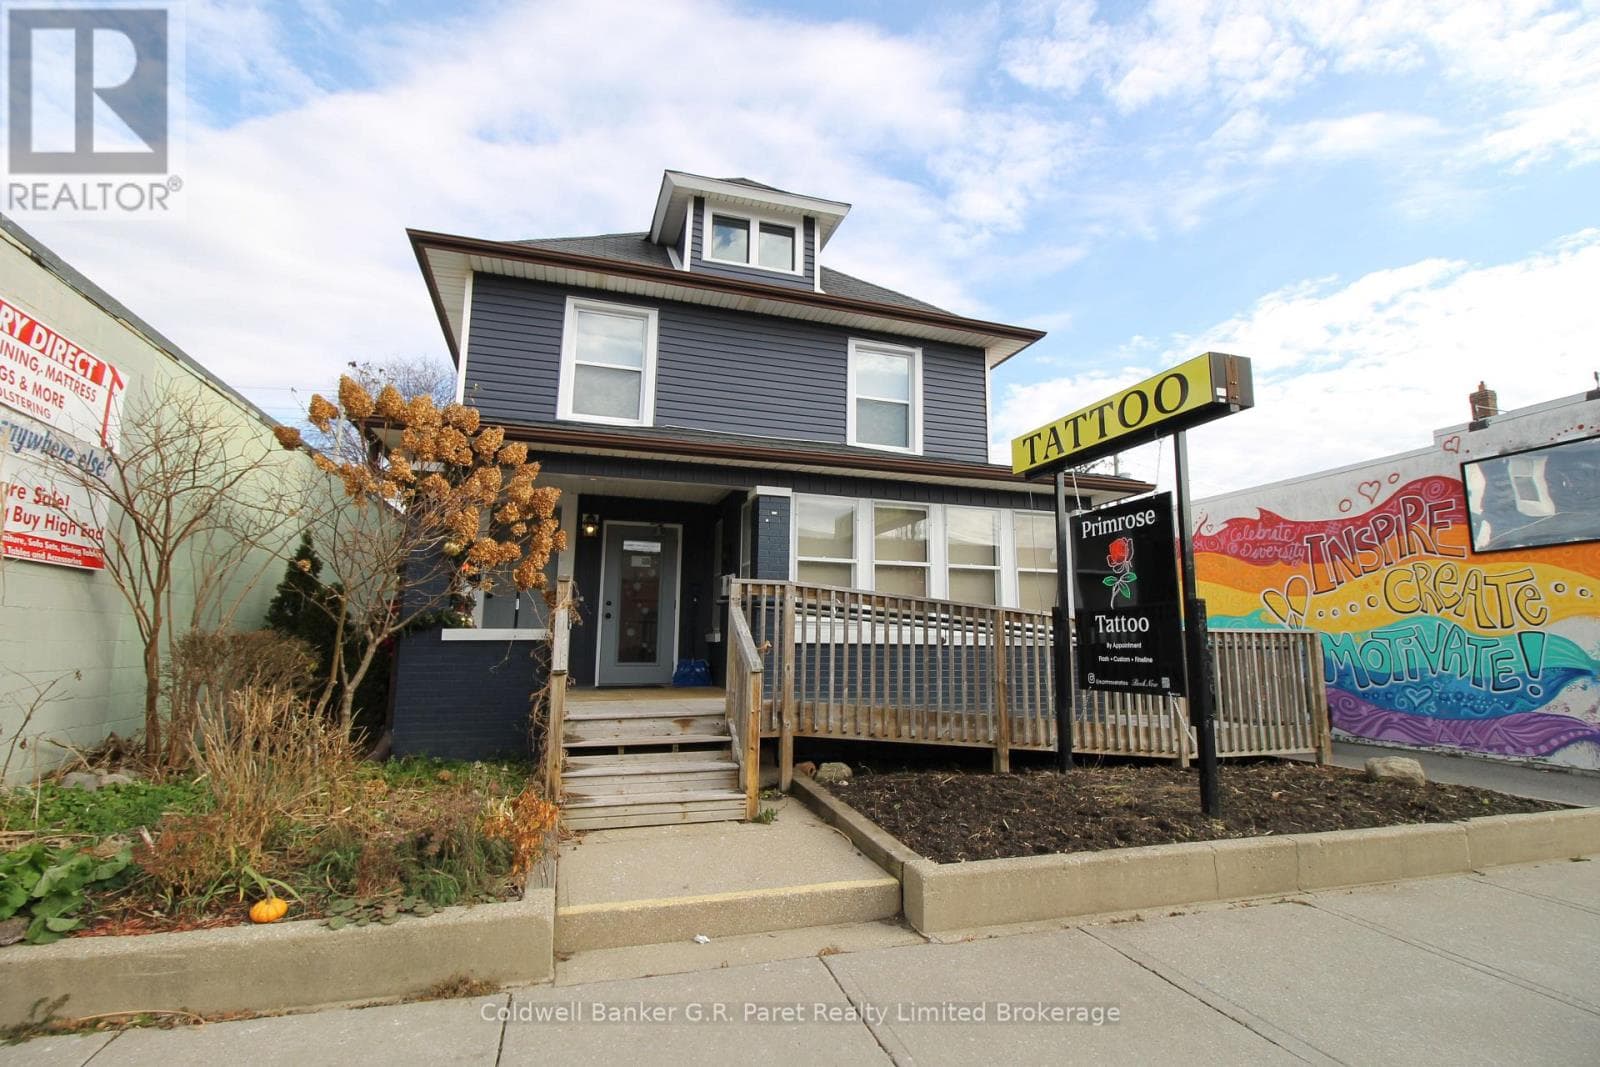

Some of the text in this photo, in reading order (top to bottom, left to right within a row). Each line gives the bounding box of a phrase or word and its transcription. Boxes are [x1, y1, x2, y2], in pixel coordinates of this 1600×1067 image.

[29, 324, 98, 380] DIRECT
[20, 376, 28, 391] &
[32, 381, 65, 409] MORE
[45, 365, 97, 403] MATTRESS
[1022, 373, 1189, 466] TATTOO
[13, 505, 41, 531] Buy
[45, 513, 76, 537] High
[1082, 508, 1156, 539] Primrose
[1230, 522, 1297, 542] Celebrate
[1240, 541, 1306, 568] Diversity
[1305, 495, 1468, 595] INSPIRE
[1095, 614, 1150, 634] Tattoo
[1113, 642, 1142, 650] Appointment
